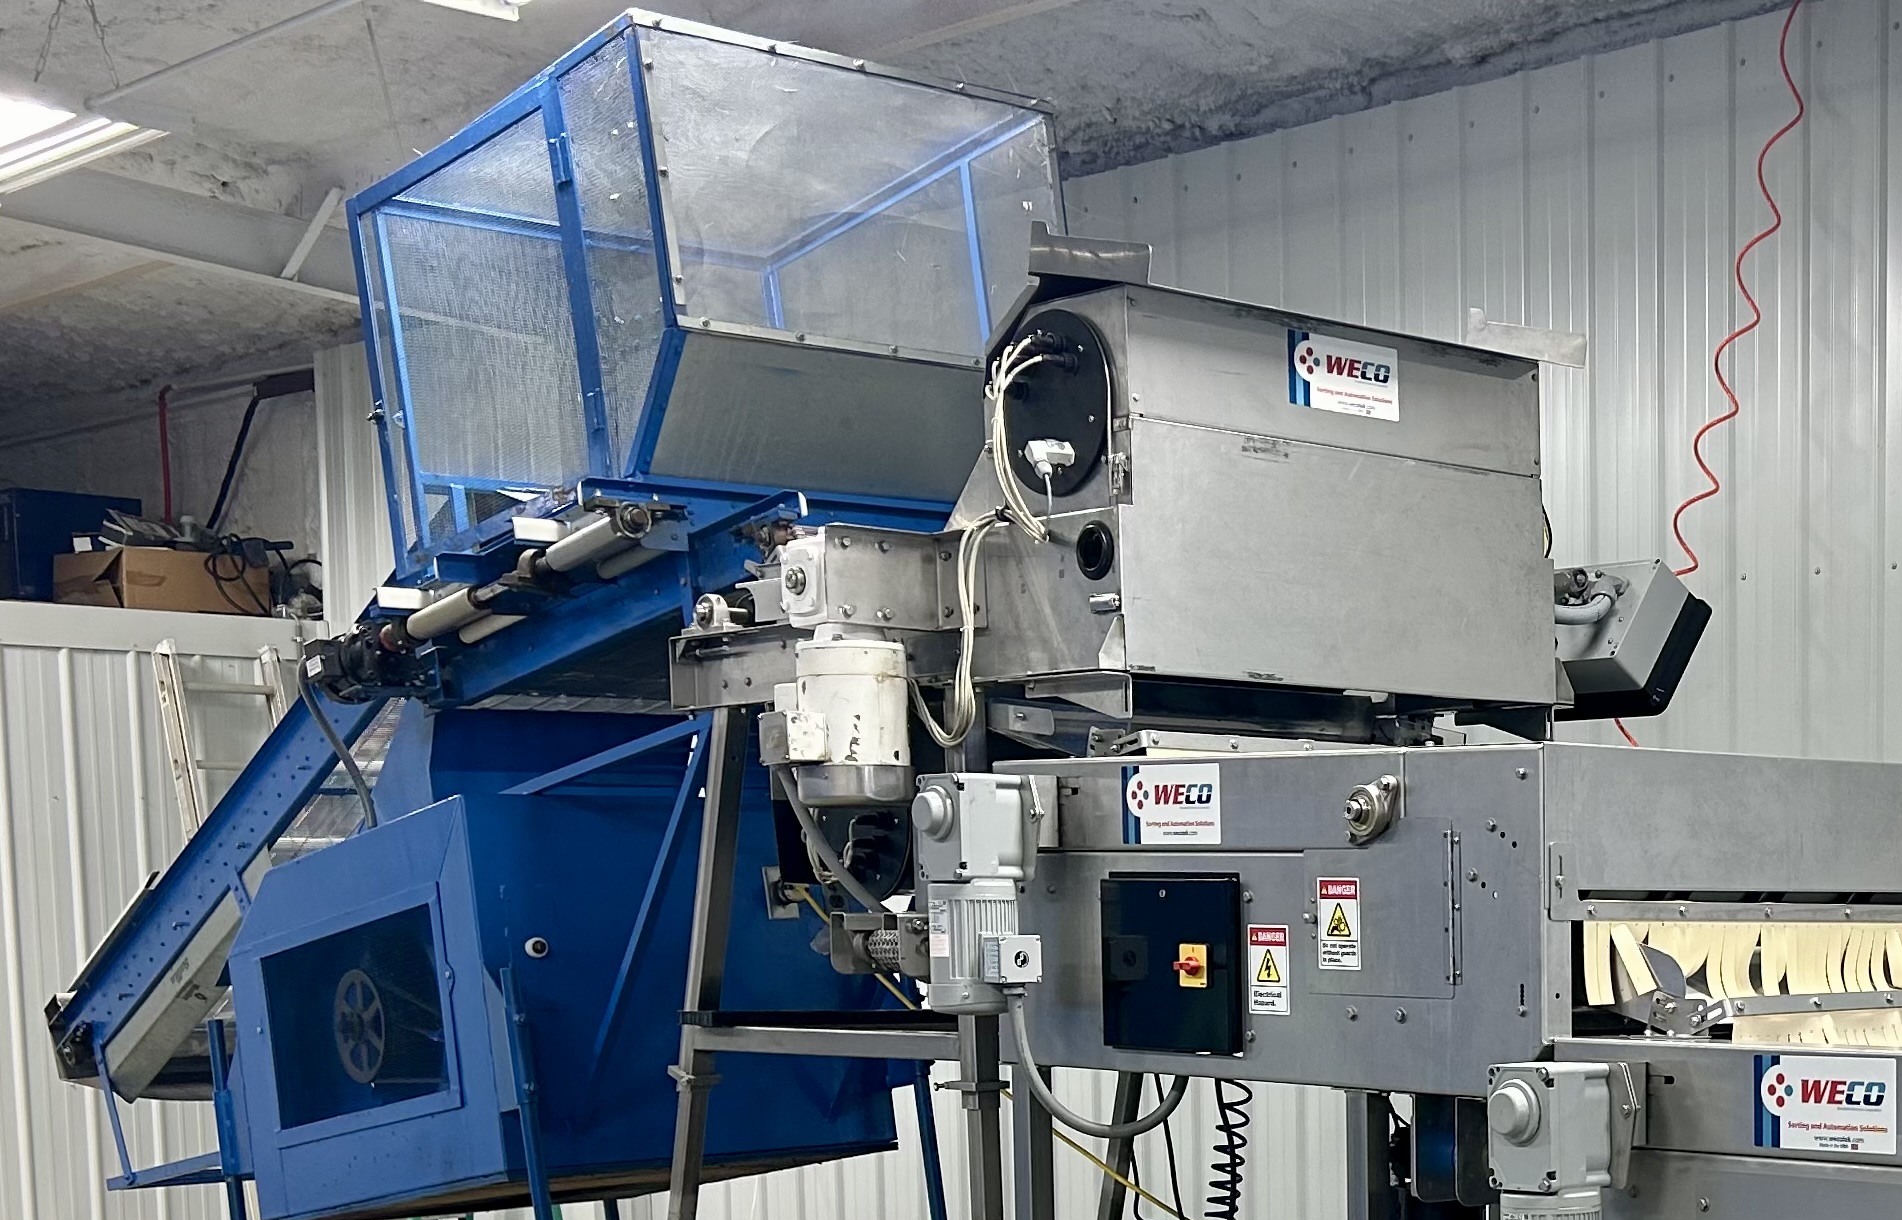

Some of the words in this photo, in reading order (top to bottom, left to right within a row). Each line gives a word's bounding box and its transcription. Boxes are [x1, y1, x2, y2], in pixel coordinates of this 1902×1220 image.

[1326, 354, 1391, 384] WECO
[1154, 783, 1213, 805] WECO
[1327, 884, 1356, 896] DANGER
[1257, 931, 1285, 942] DANGER
[1800, 1079, 1886, 1106] WECO
[1788, 1121, 1810, 1131] Sorting
[1810, 1122, 1822, 1130] and
